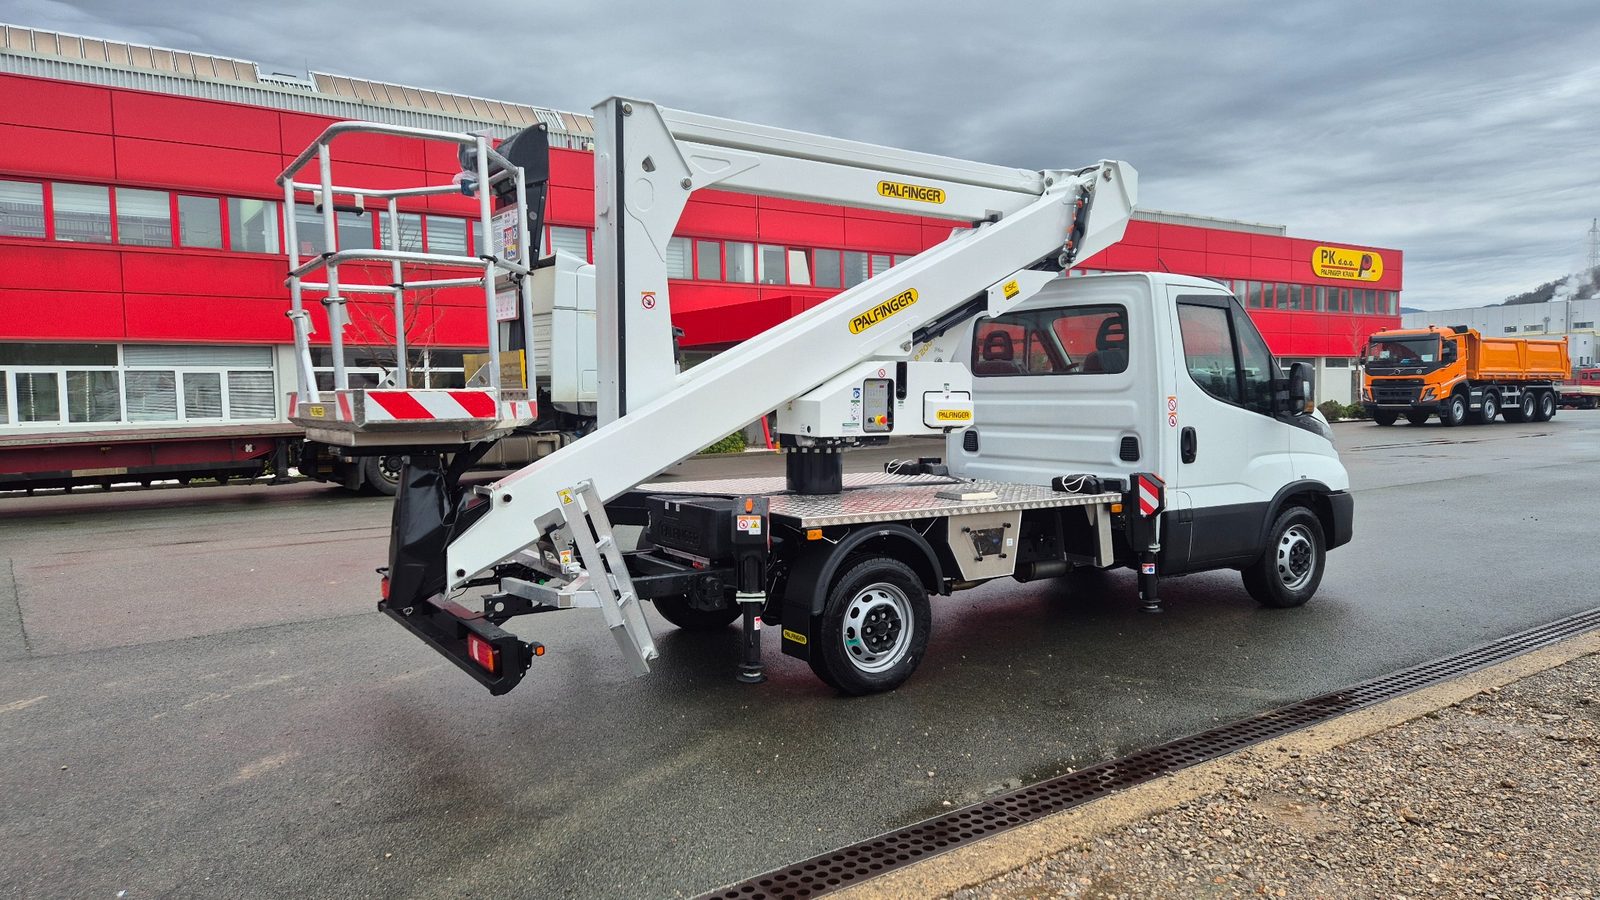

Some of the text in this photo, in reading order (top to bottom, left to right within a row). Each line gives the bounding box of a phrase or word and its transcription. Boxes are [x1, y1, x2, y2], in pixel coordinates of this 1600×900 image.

[882, 183, 941, 202] PALFINGER
[1321, 249, 1355, 267] PK d.o.o.
[853, 291, 914, 332] PALFINGER
[938, 411, 970, 419] PALFINGER
